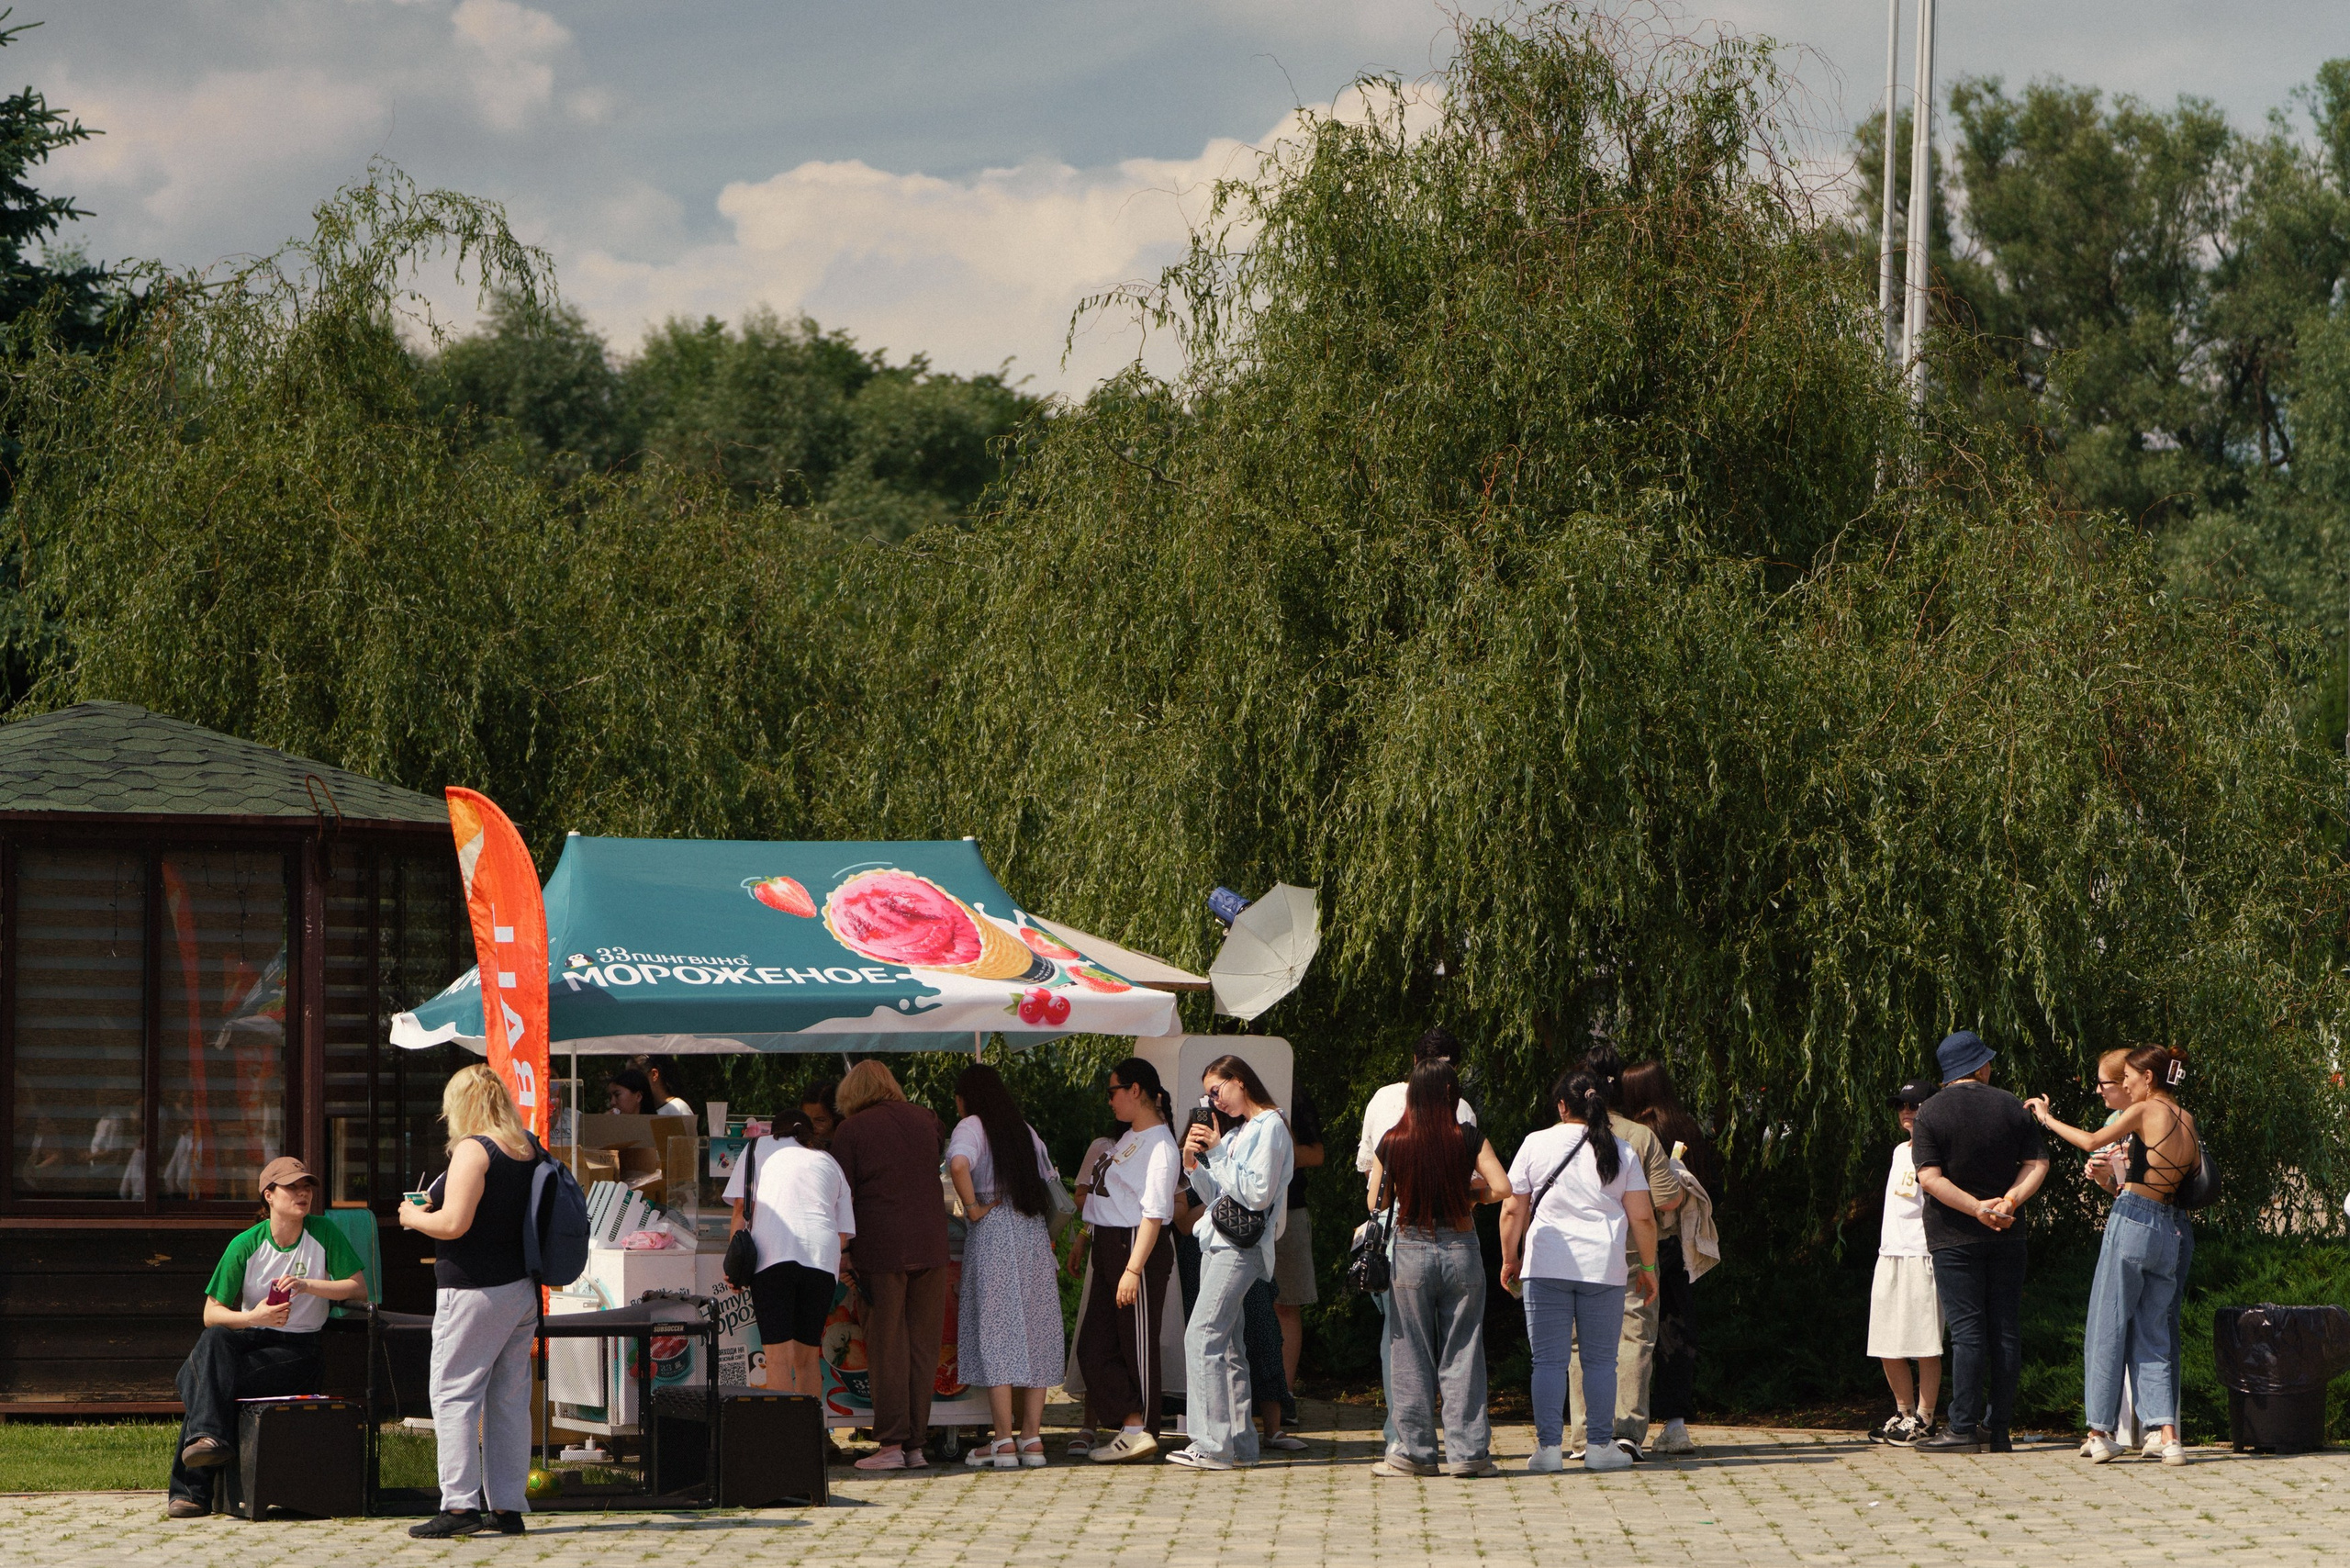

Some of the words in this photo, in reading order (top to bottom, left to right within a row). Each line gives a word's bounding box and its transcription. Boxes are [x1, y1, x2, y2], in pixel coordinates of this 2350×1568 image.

[562, 964, 897, 991] МОРОЖЕНОЕ
[1901, 1171, 1915, 1187] 15
[653, 1325, 685, 1333] SUBSOCCER
